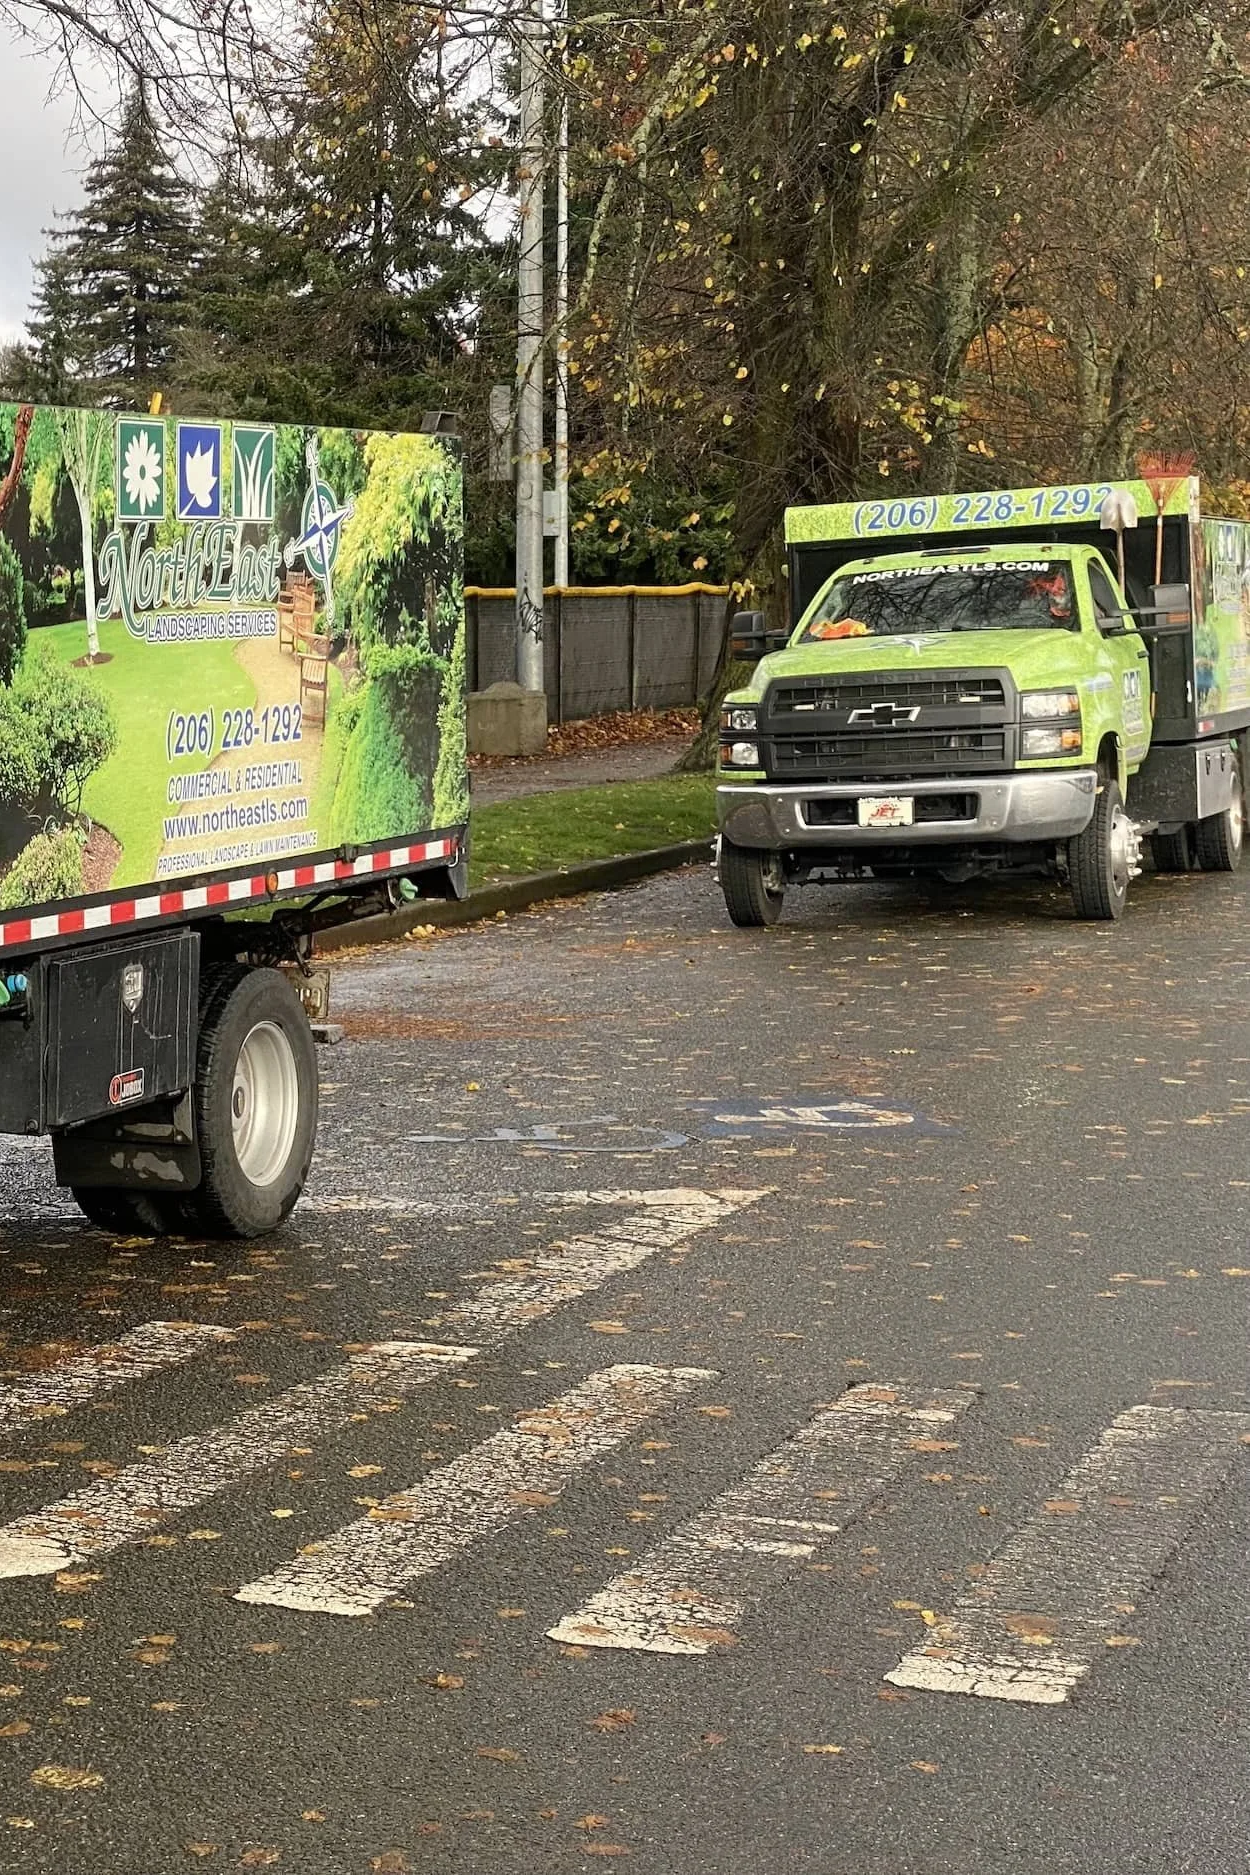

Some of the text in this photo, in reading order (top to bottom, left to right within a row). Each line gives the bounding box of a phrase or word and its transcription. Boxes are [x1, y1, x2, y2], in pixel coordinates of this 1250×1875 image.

[854, 485, 1112, 534] (206) 228-1292
[852, 562, 1049, 585] NORTHEASTLS.COM
[147, 611, 277, 640] LANDSCAPING SERVICES
[167, 704, 303, 762] (206) 228-1292
[168, 761, 302, 802] COMMERCIAL & RESIDENTIAL
[164, 797, 308, 840] www.northeastls.com
[158, 853, 209, 873] PROFESSIONAL
[210, 843, 249, 864] LANDSCAPE
[255, 839, 273, 857] LAWN
[275, 832, 318, 852] MAINTENANCE
